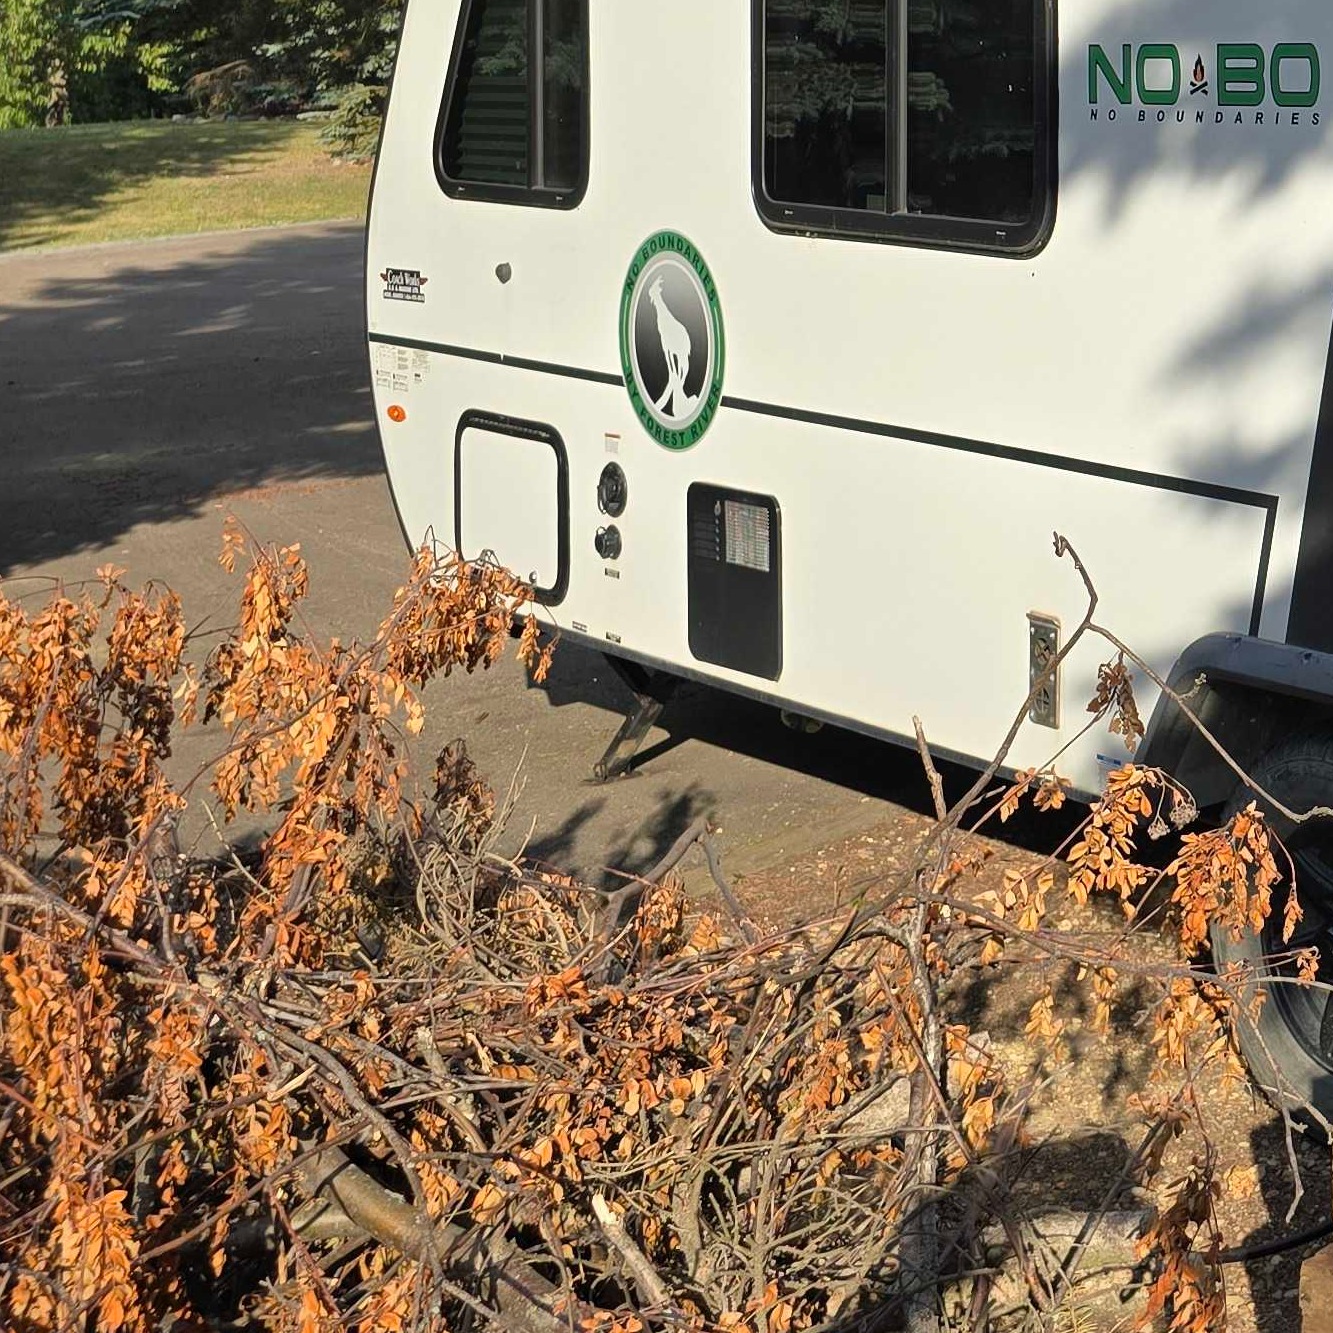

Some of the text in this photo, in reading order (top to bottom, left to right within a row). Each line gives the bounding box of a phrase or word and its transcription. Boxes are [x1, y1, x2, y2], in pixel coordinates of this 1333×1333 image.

[1090, 109, 1321, 126] NO BOUNDARIES
[626, 234, 717, 303] NO BOUNDARIES
[639, 407, 685, 447] FOREST
[689, 383, 721, 440] RIVER
